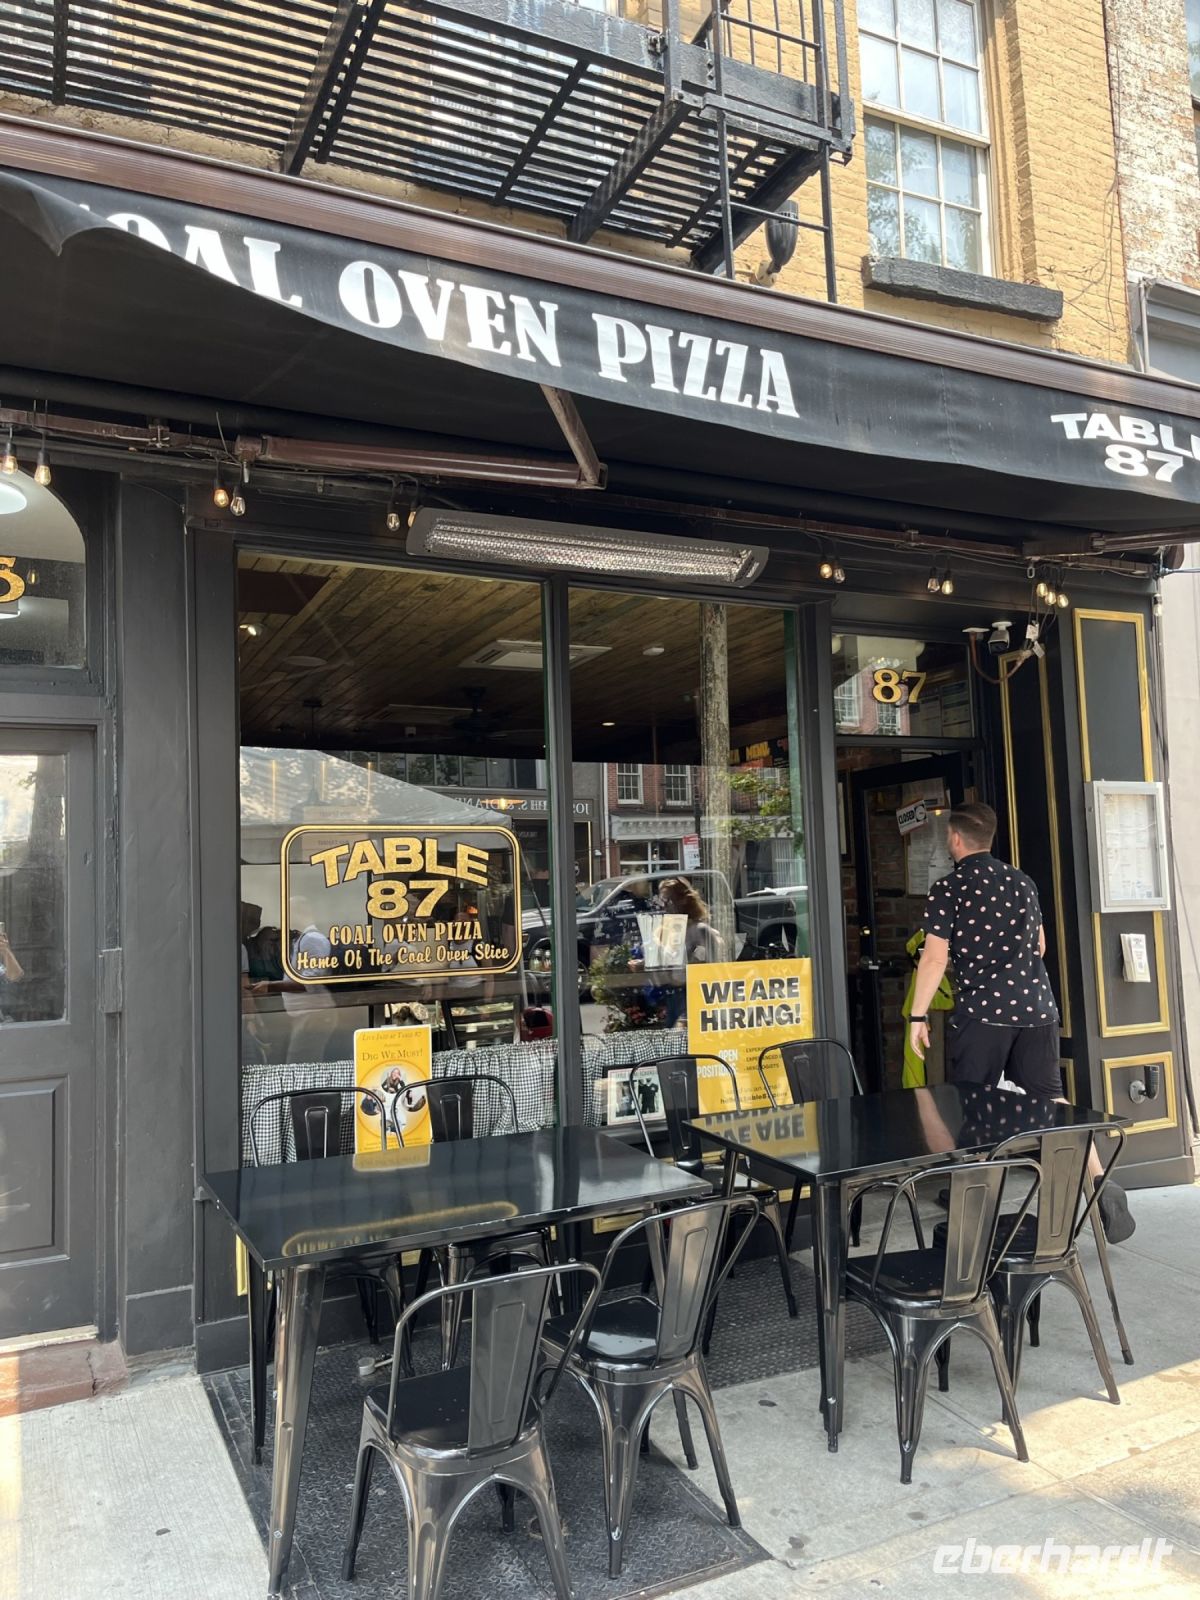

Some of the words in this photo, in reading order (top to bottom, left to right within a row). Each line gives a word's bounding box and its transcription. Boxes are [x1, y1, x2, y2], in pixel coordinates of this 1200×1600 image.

[80, 204, 303, 308] AL
[338, 261, 562, 367] OVEN
[592, 312, 800, 418] PIZZA
[1104, 443, 1184, 483] 87
[871, 668, 928, 704] 87
[310, 836, 490, 889] TABLE
[366, 879, 449, 920] 87
[329, 925, 375, 946] COAL
[382, 922, 427, 943] OVEN
[434, 921, 483, 942] PIZZA
[296, 952, 338, 970] Home
[344, 950, 363, 969] Of
[368, 948, 393, 966] The
[397, 945, 432, 963] Coal
[436, 945, 470, 962] Oven
[475, 943, 509, 961] Slice
[700, 980, 746, 1005] WE
[749, 976, 800, 1001] ARE
[700, 1003, 801, 1032] HIRING!
